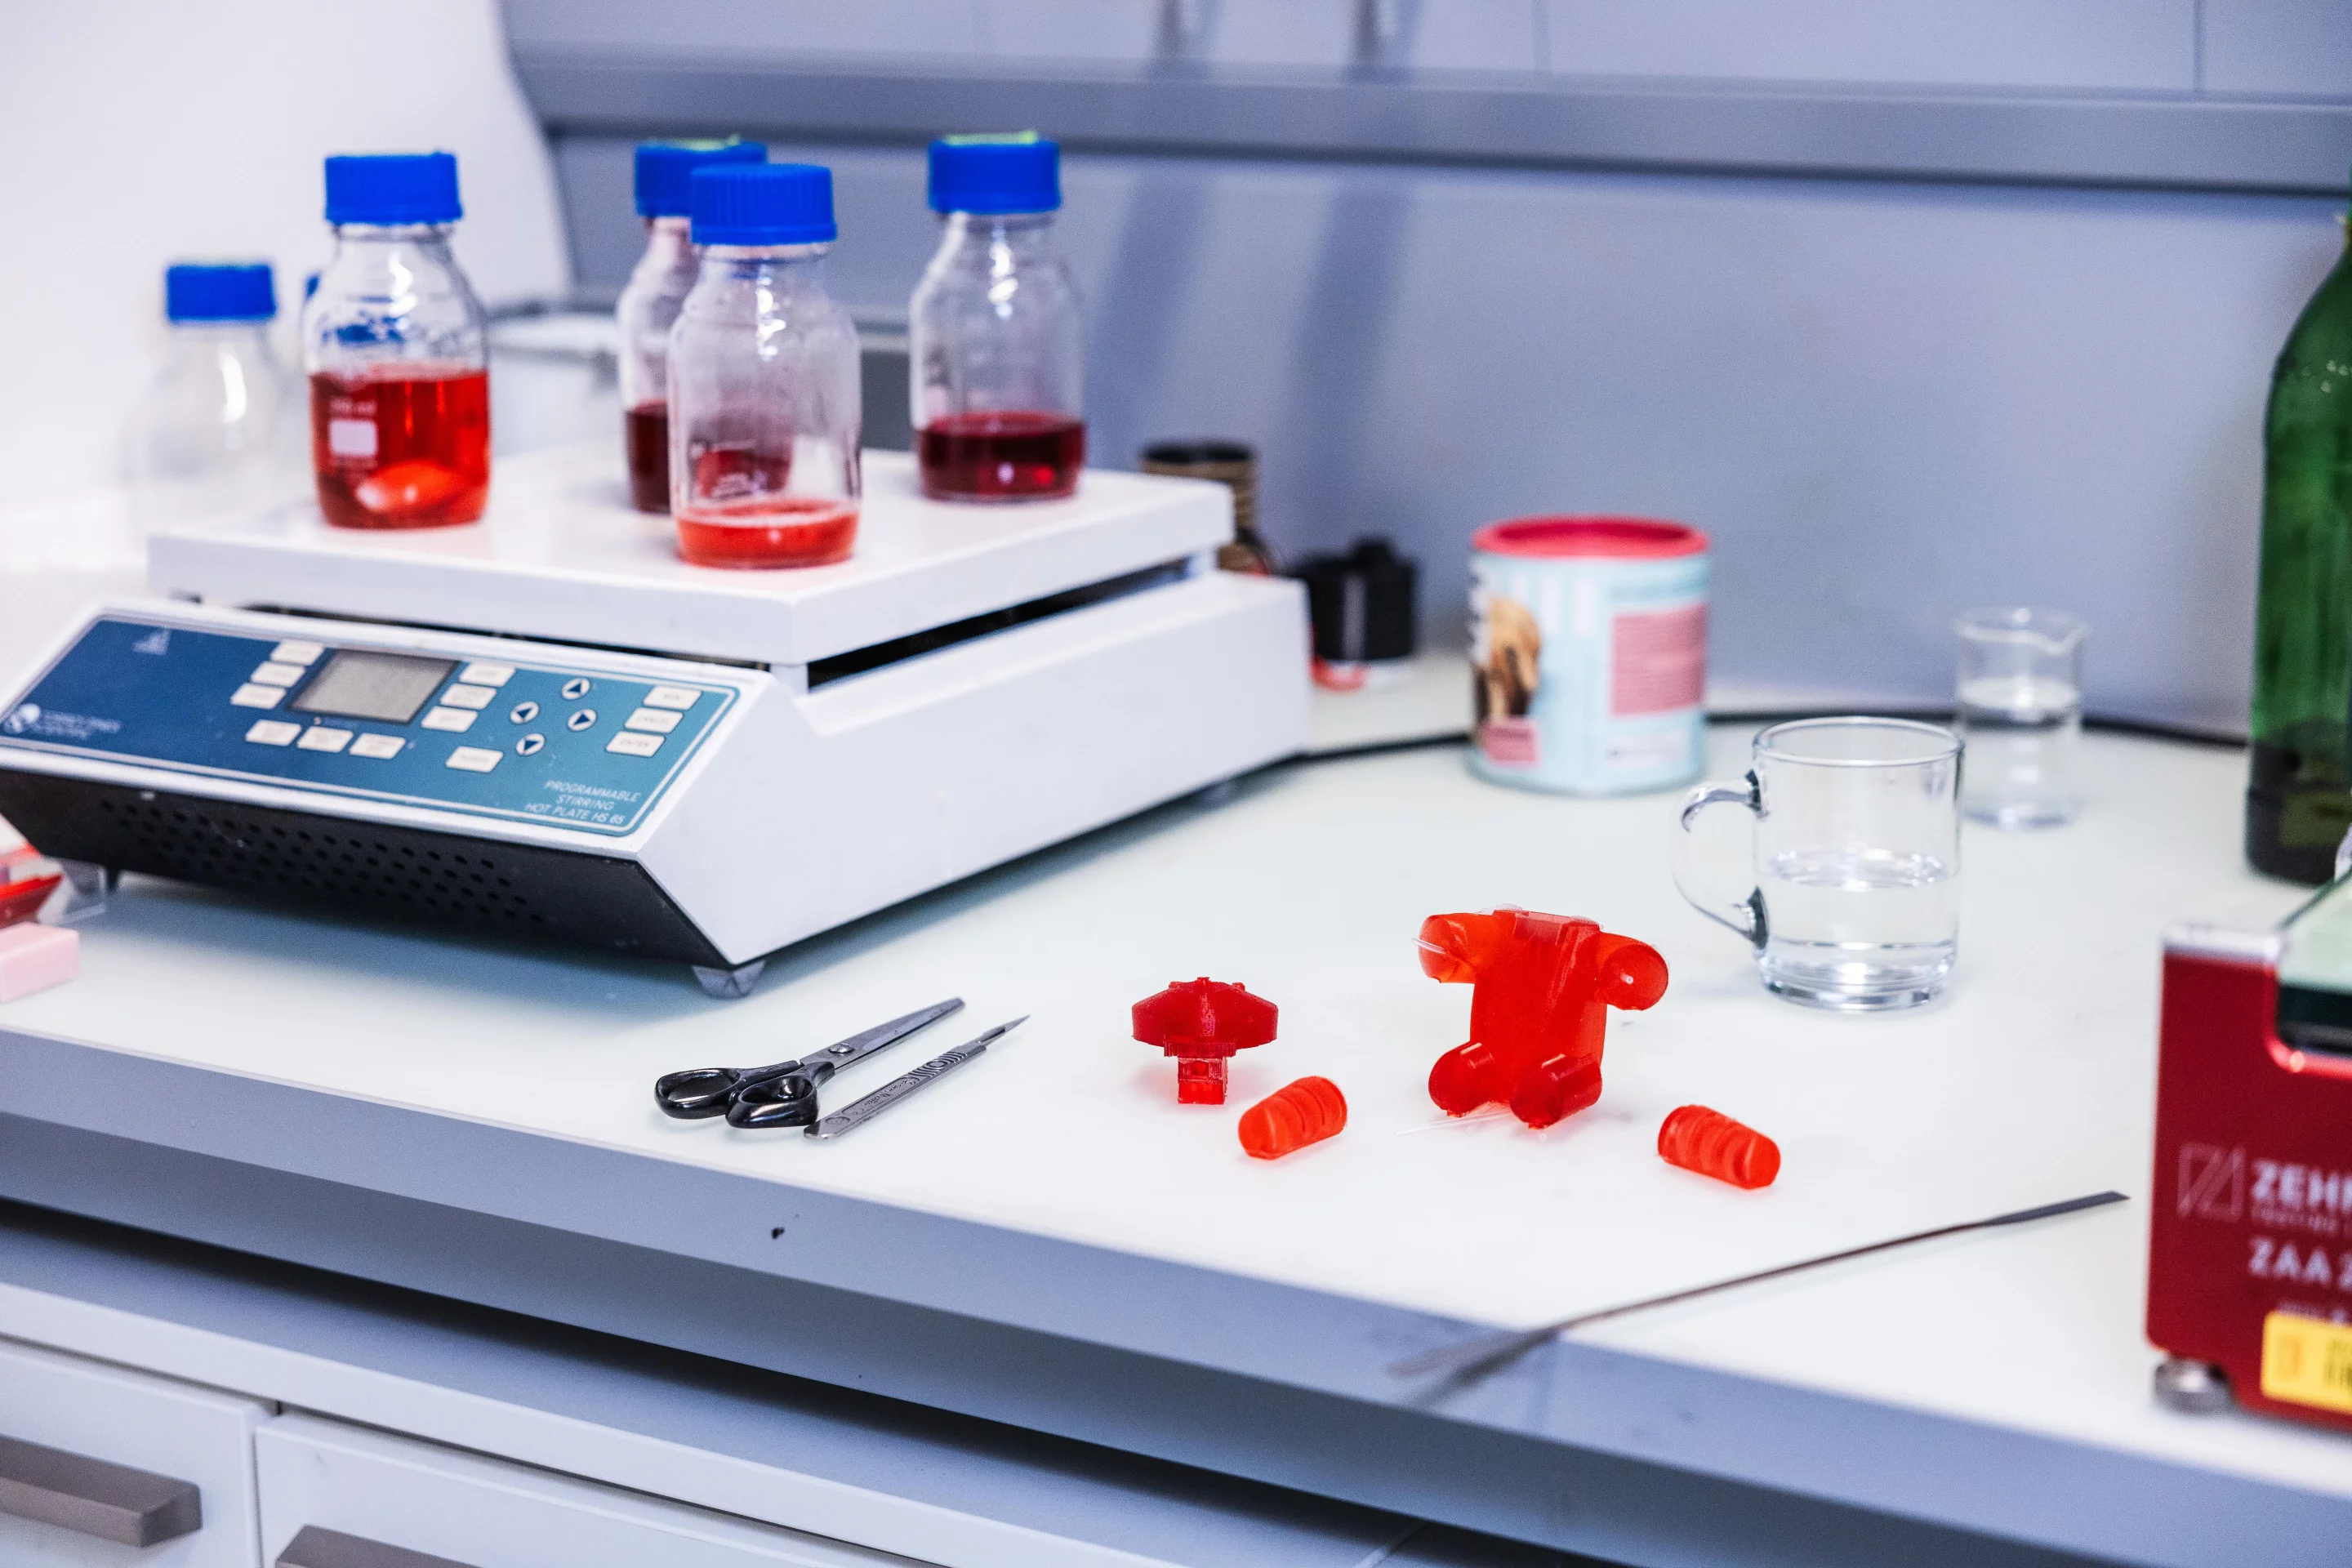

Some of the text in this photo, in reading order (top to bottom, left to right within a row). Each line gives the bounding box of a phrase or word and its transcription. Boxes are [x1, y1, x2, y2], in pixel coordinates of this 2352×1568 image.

[544, 779, 642, 803] PROGRAMMABLE
[524, 802, 552, 813] HOT
[552, 805, 591, 820] PLATE
[591, 811, 610, 823] HS
[556, 794, 615, 811] STIRRING
[2249, 1235, 2333, 1288] ZAA
